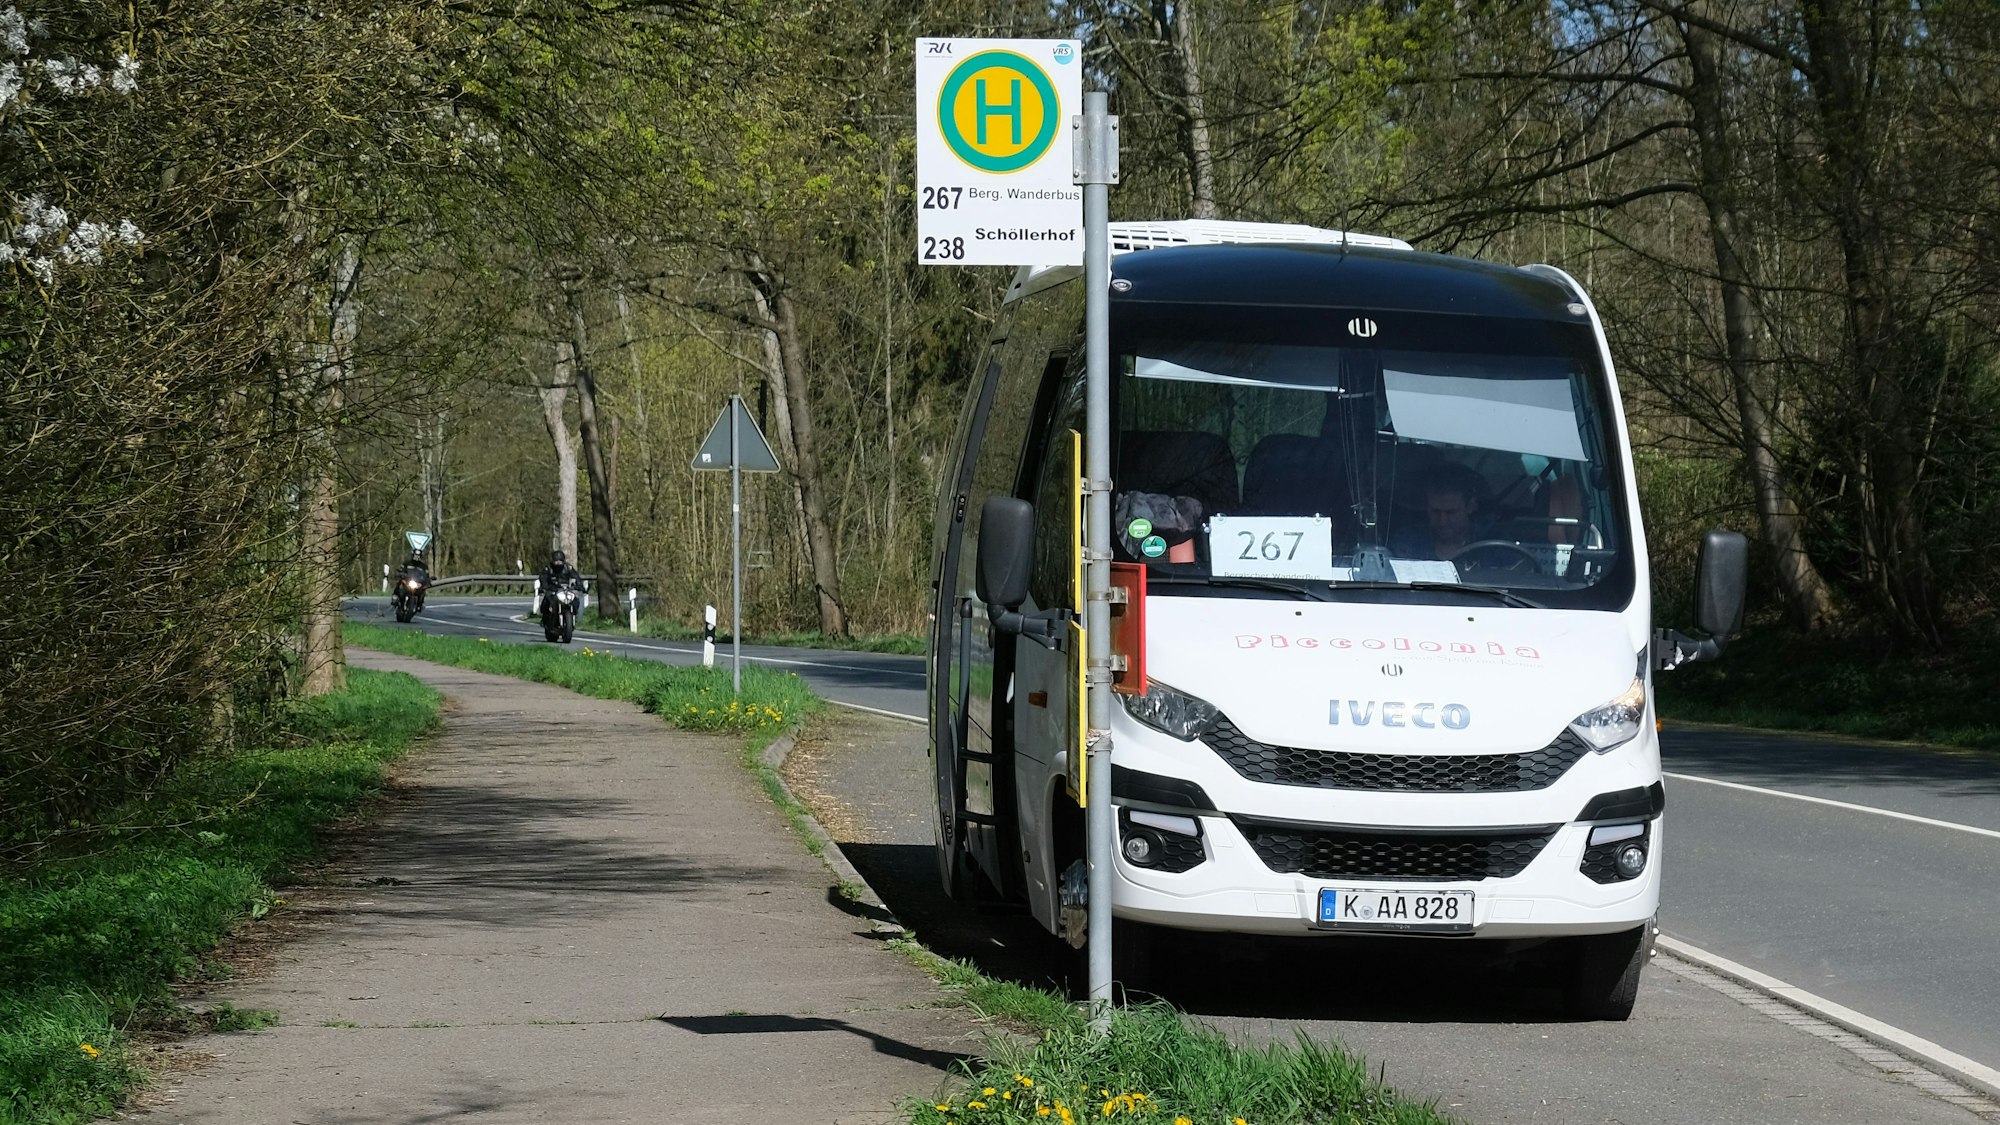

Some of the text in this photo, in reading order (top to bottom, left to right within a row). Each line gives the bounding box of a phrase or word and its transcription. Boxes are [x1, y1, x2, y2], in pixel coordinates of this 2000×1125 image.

[1052, 46, 1069, 56] VRS
[975, 78, 1022, 145] H
[922, 186, 1081, 210] 267 Berg. Wanderbus
[923, 226, 1077, 261] 238 Schöllerhof
[1237, 530, 1305, 561] 267
[1234, 633, 1541, 660] Piccolonia
[1327, 698, 1472, 731] IVECO
[1324, 894, 1460, 921] D K AA 828
